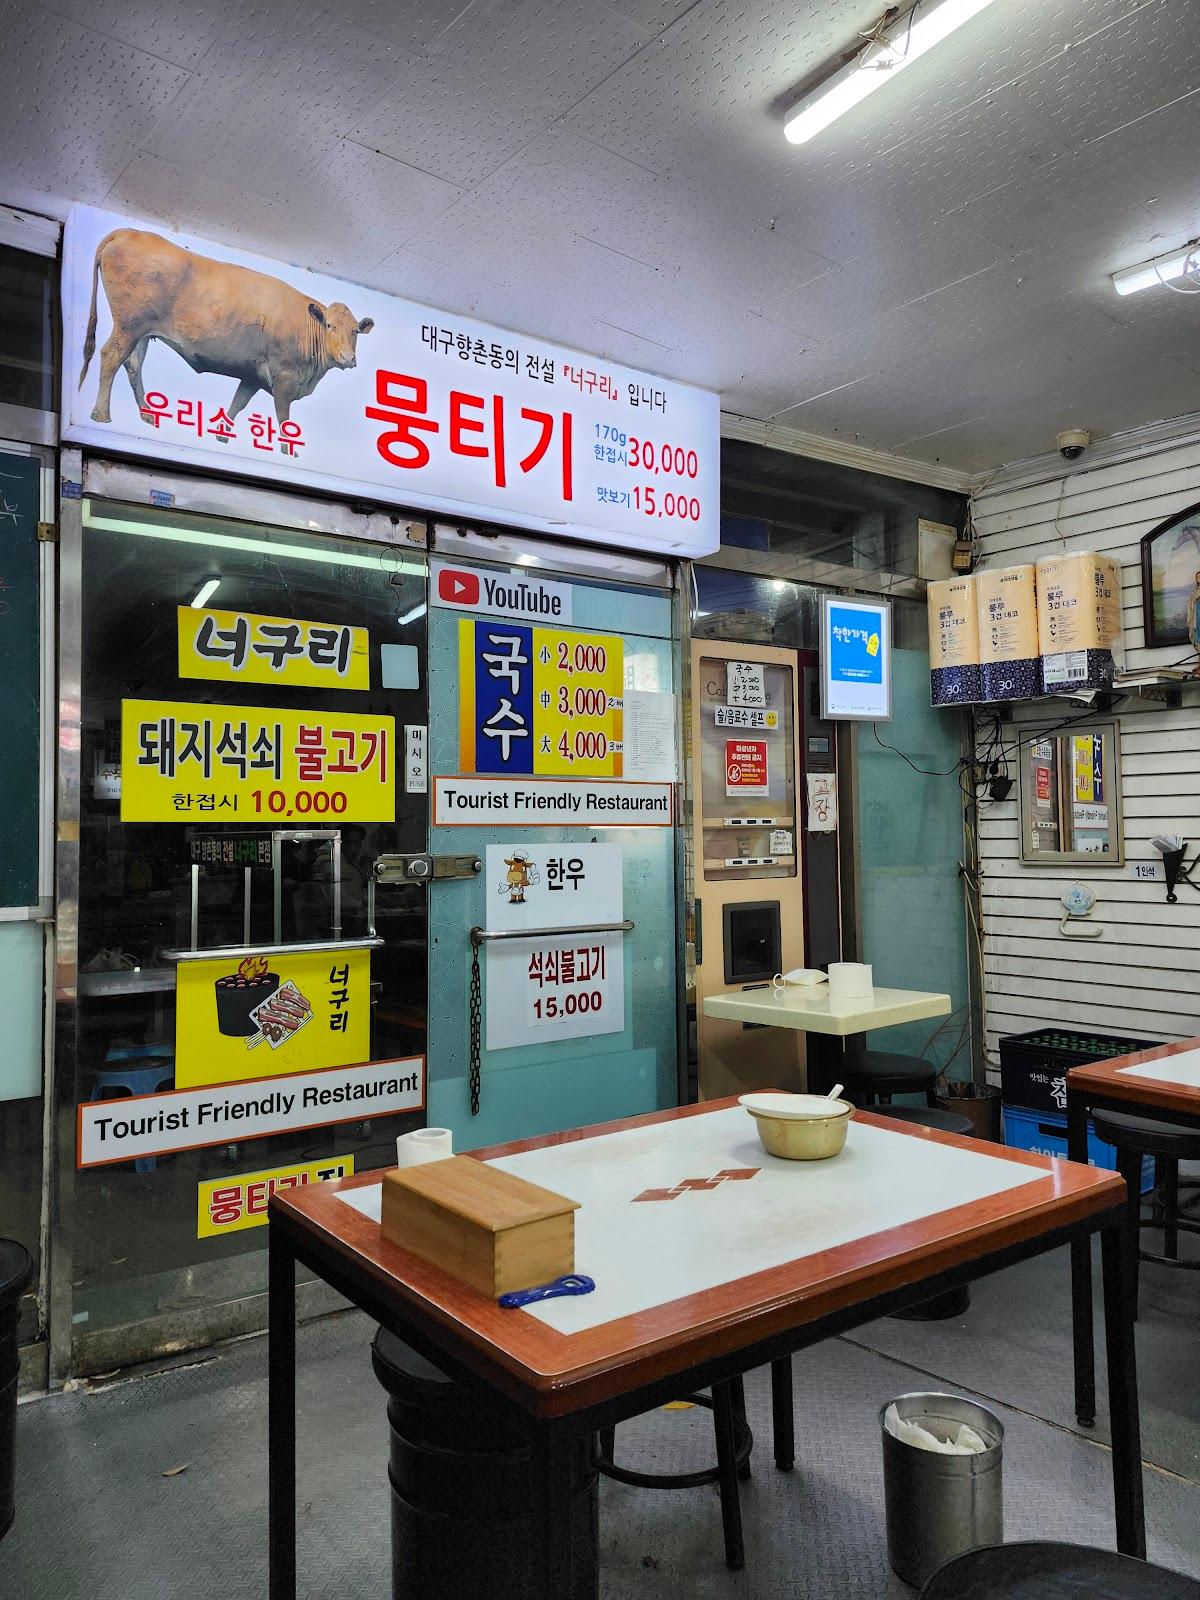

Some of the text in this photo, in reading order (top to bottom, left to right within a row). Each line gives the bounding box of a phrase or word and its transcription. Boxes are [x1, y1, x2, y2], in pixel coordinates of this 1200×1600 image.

[525, 354, 555, 384] 전설
[628, 383, 667, 413] 입니다
[140, 391, 305, 456] 우리소 한우
[364, 368, 574, 501] 뭉티기
[595, 424, 626, 446] 170g
[594, 437, 698, 479] 한접시 30,000
[597, 486, 700, 521] 맛보기 15,000
[484, 578, 561, 616] YouTube
[195, 617, 352, 676] 너구리
[833, 625, 869, 643] 착한가격
[540, 642, 606, 675] 小 2,000
[736, 664, 753, 675] 국수
[482, 634, 529, 762] 국수
[540, 686, 606, 719] 中 3,000
[717, 708, 765, 727] 술/음료수 셀프
[138, 718, 387, 784] 돼지석쇠 불고기
[411, 729, 422, 777] 미시오
[540, 729, 607, 762] 大 4,000
[172, 790, 348, 815] 한접시 10,000
[444, 790, 668, 812] Tourist Friendly Restaurant
[546, 858, 586, 890] 한우
[1135, 865, 1155, 877] 1인석
[528, 946, 605, 988] 석쇠불고기
[329, 963, 350, 1034] 너구리
[533, 991, 602, 1019] 15,000
[1029, 1072, 1050, 1084] 맛있는
[94, 1073, 417, 1140] Tourist Friendly Restaurant
